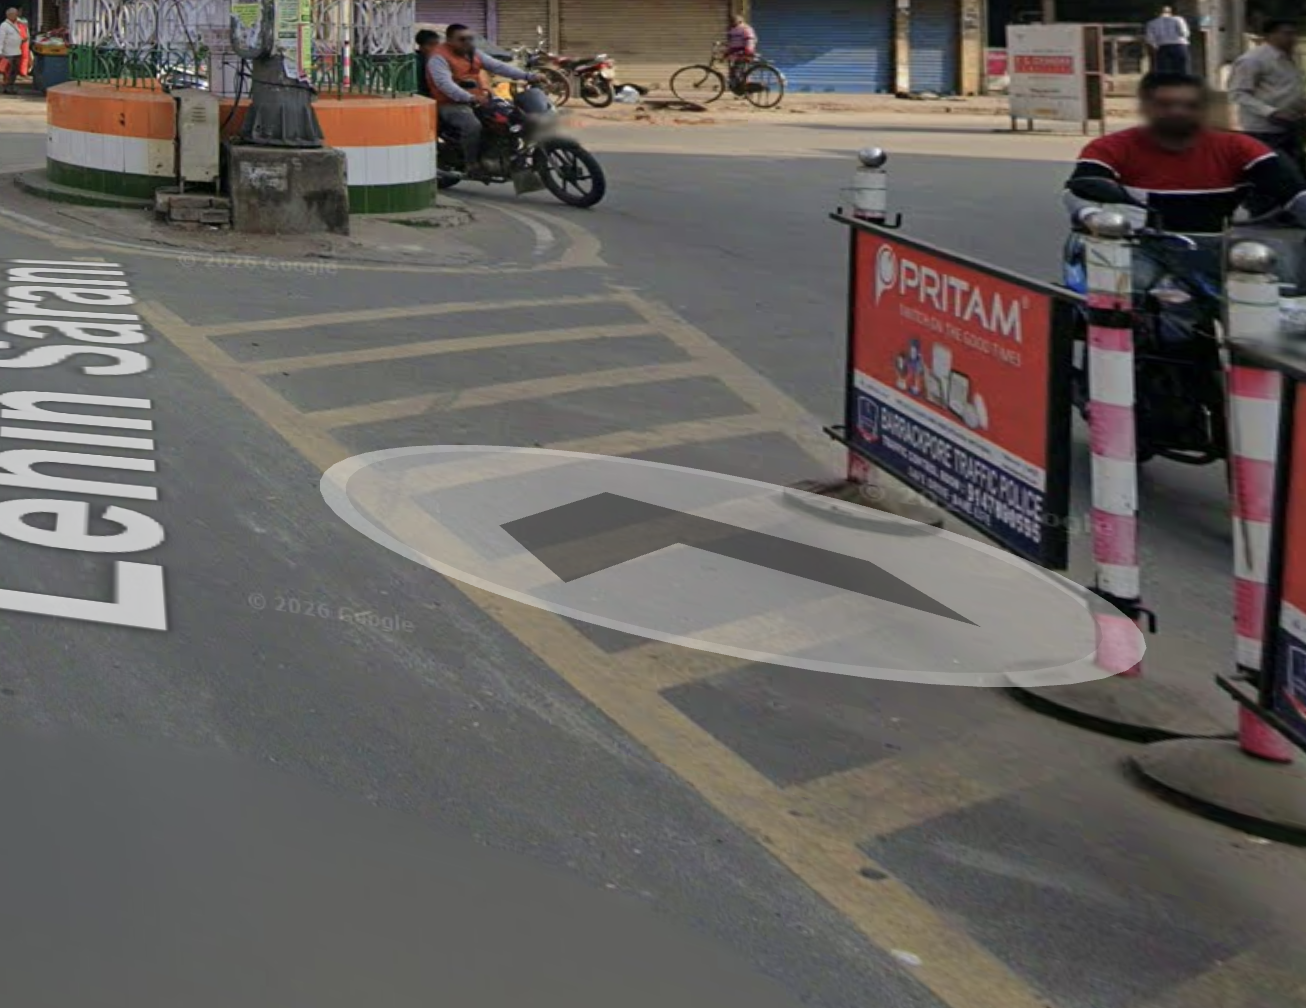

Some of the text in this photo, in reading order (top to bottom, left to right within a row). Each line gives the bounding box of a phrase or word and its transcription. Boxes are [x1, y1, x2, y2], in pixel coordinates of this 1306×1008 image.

[899, 258, 1022, 344] PRITAM
[880, 407, 953, 469] BARRACKPORE
[954, 450, 999, 496] TRAFFIC
[999, 474, 1044, 521] POLICE
